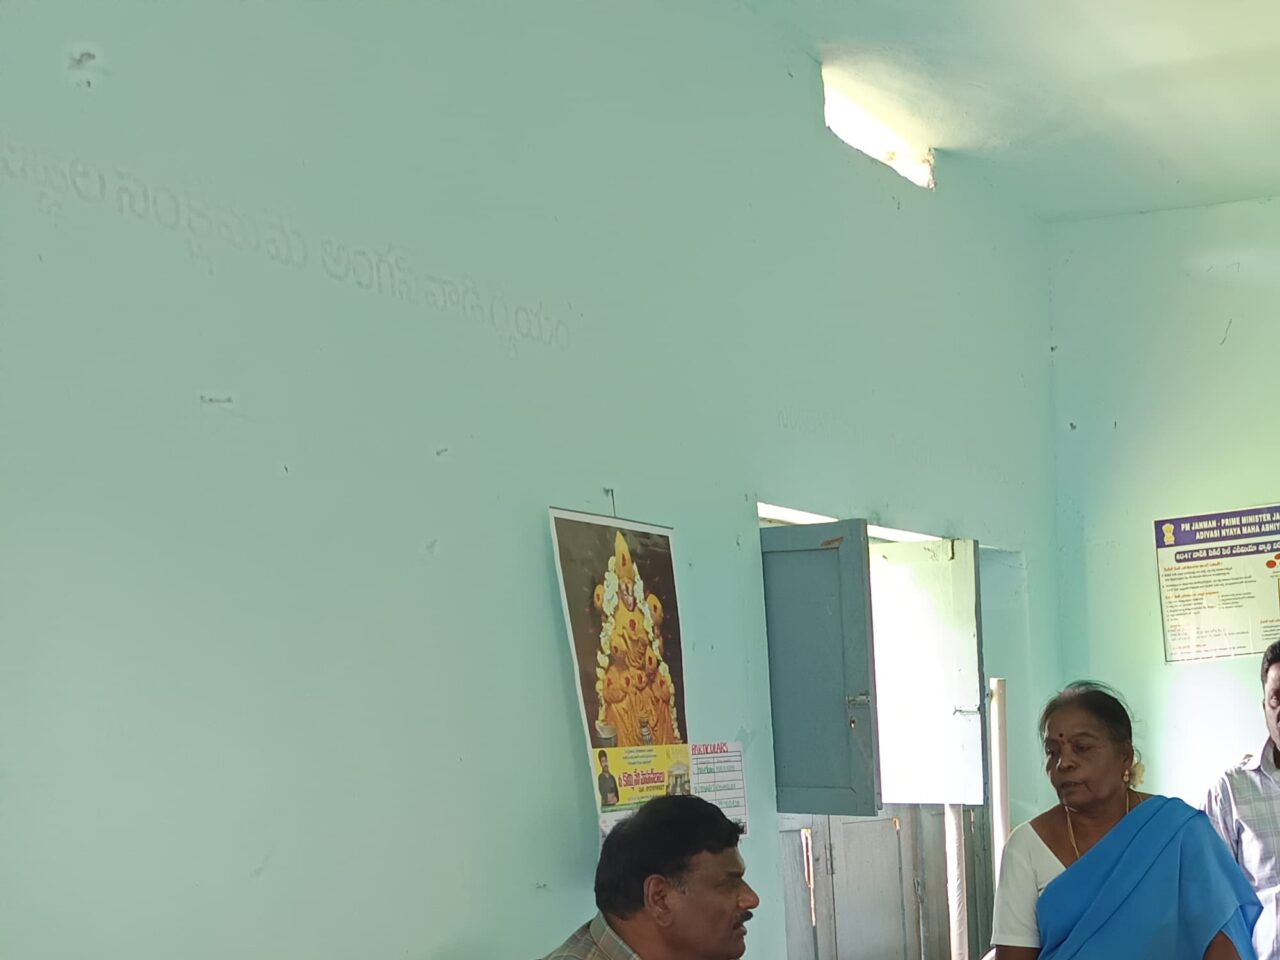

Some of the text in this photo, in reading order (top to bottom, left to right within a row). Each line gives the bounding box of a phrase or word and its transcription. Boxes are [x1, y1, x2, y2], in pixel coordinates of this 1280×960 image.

[1181, 522, 1191, 532] PM
[1191, 520, 1216, 531] JANMAN
[1221, 517, 1240, 527] PRIME
[1241, 512, 1272, 525] MINISTER
[1196, 529, 1220, 540] ADIVASI
[1221, 526, 1241, 537] NYAYA
[1242, 524, 1260, 534] MAHA
